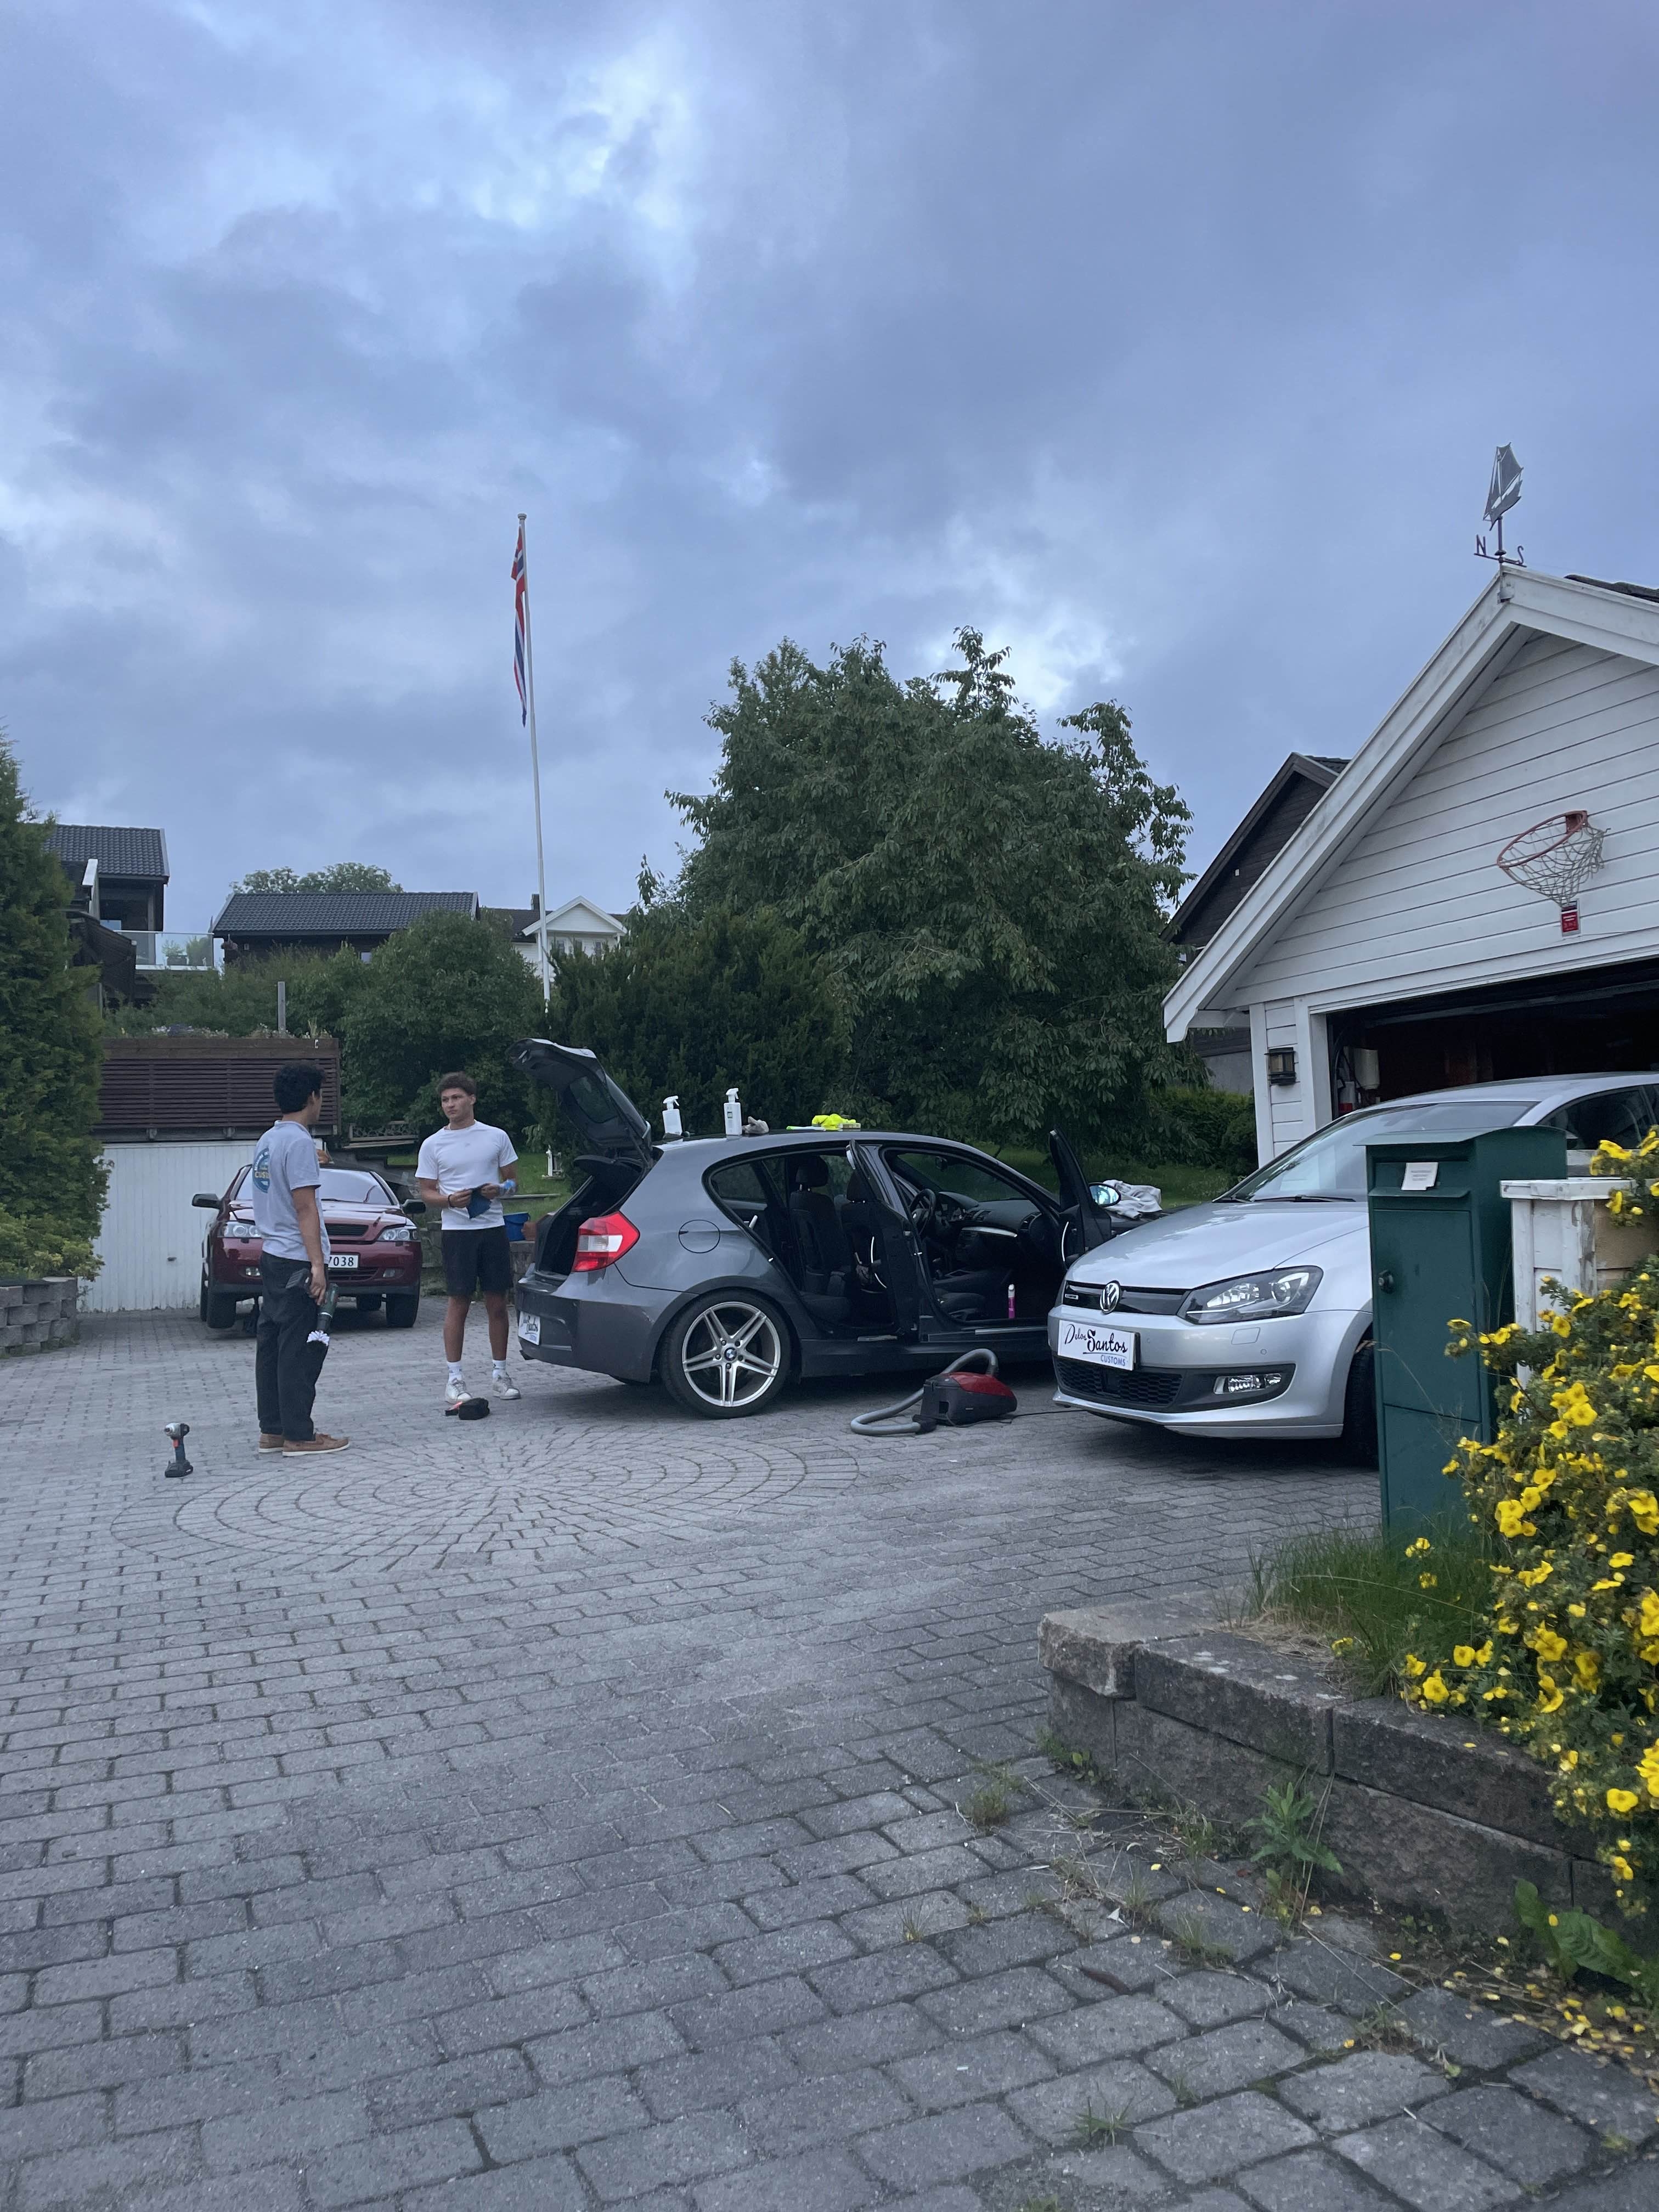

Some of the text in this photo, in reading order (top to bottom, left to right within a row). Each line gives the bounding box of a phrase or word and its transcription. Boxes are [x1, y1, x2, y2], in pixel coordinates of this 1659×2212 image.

[1476, 534, 1487, 556] N
[1517, 545, 1524, 565] S
[1087, 1329, 1127, 1353] Santos
[1101, 1355, 1126, 1366] CUSTOMS
